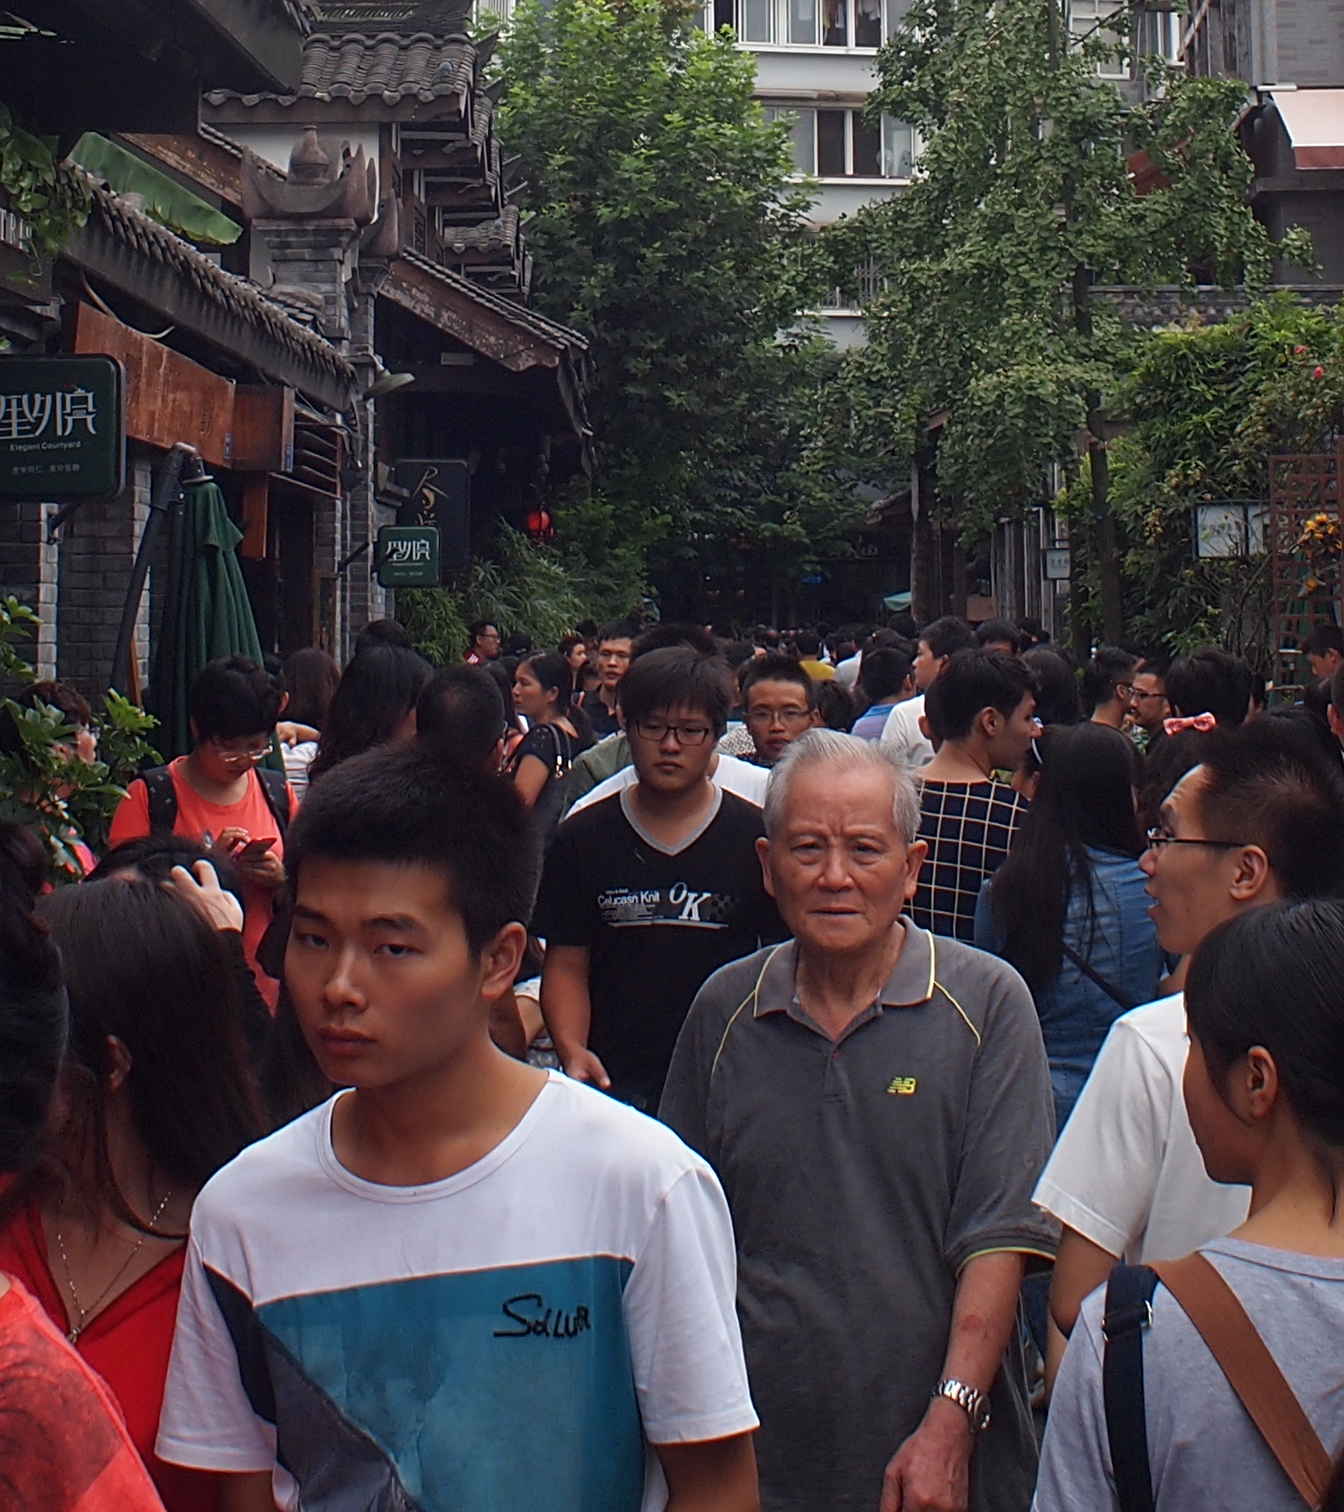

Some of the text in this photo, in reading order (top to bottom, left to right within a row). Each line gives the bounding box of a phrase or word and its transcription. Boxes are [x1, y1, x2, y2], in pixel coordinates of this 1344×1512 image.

[9, 440, 82, 453] Elegant Courtyard
[639, 890, 661, 903] Knit
[669, 881, 712, 921] OK
